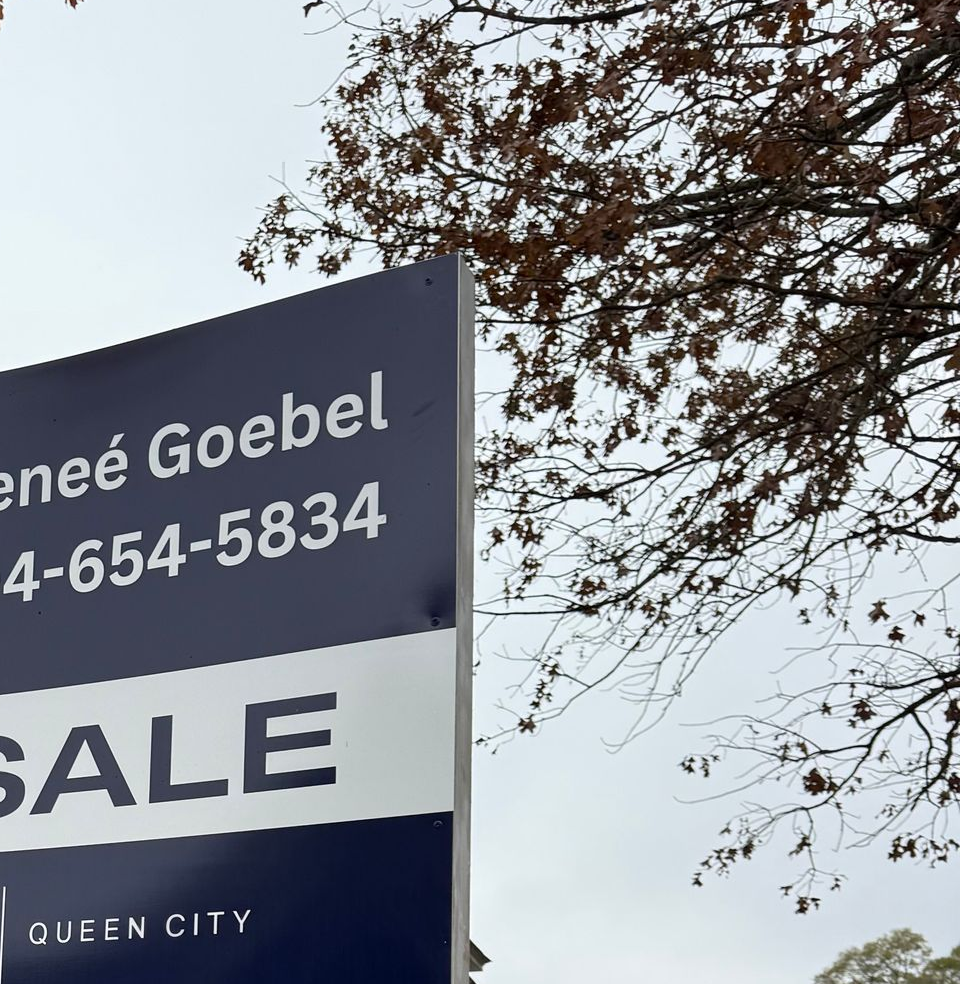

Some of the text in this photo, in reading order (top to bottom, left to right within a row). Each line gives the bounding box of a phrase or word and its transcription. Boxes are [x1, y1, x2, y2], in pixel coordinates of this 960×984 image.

[148, 370, 390, 479] Goebel
[28, 909, 252, 946] QUEEN CITY
